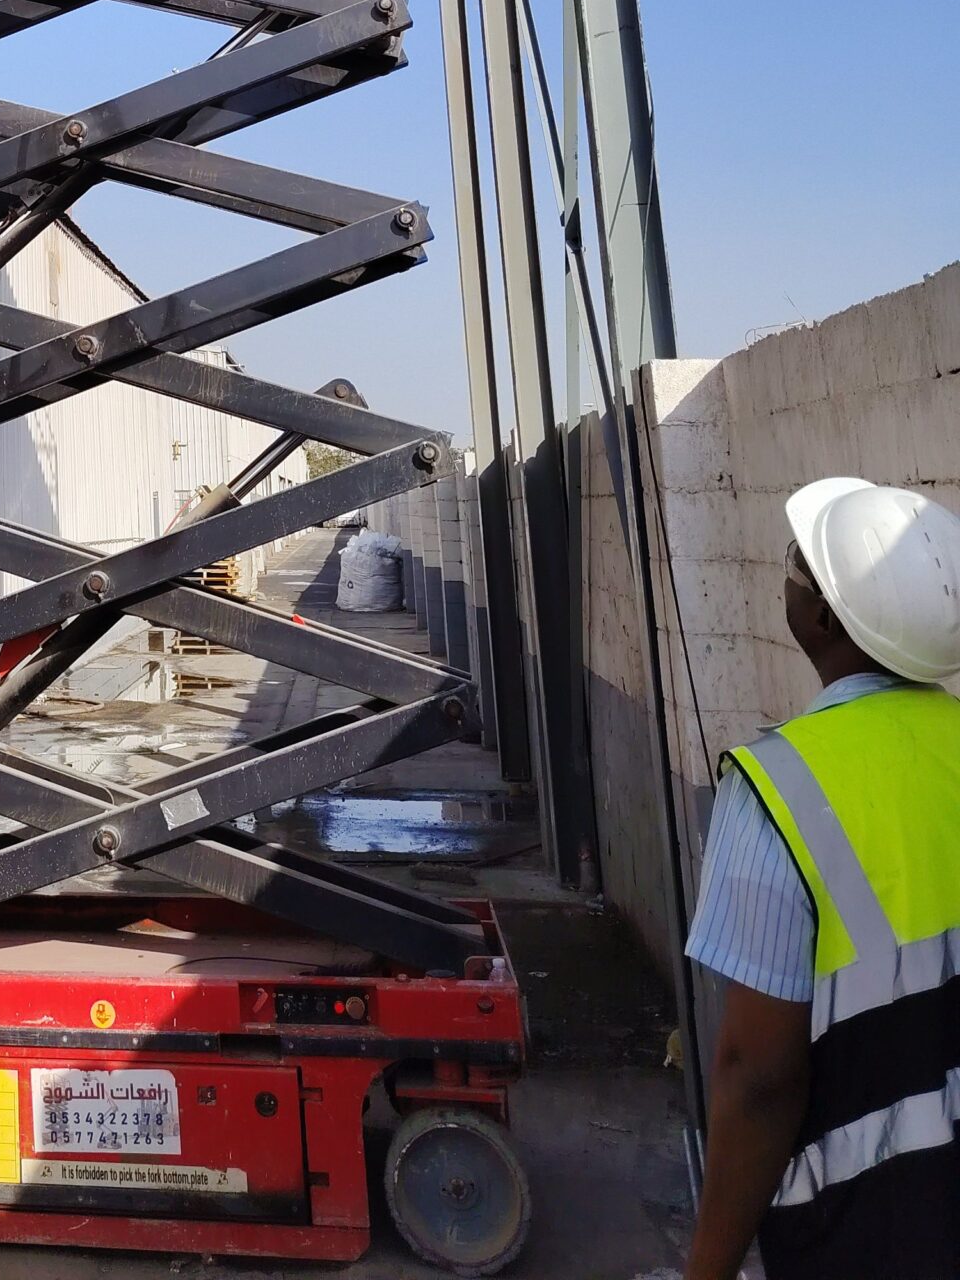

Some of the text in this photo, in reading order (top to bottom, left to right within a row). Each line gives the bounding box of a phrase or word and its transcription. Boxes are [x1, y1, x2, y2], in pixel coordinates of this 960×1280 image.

[43, 1082, 168, 1105] رافعات الشموخ
[61, 1164, 209, 1187] It is forbidden to pick the fork bottom plate
